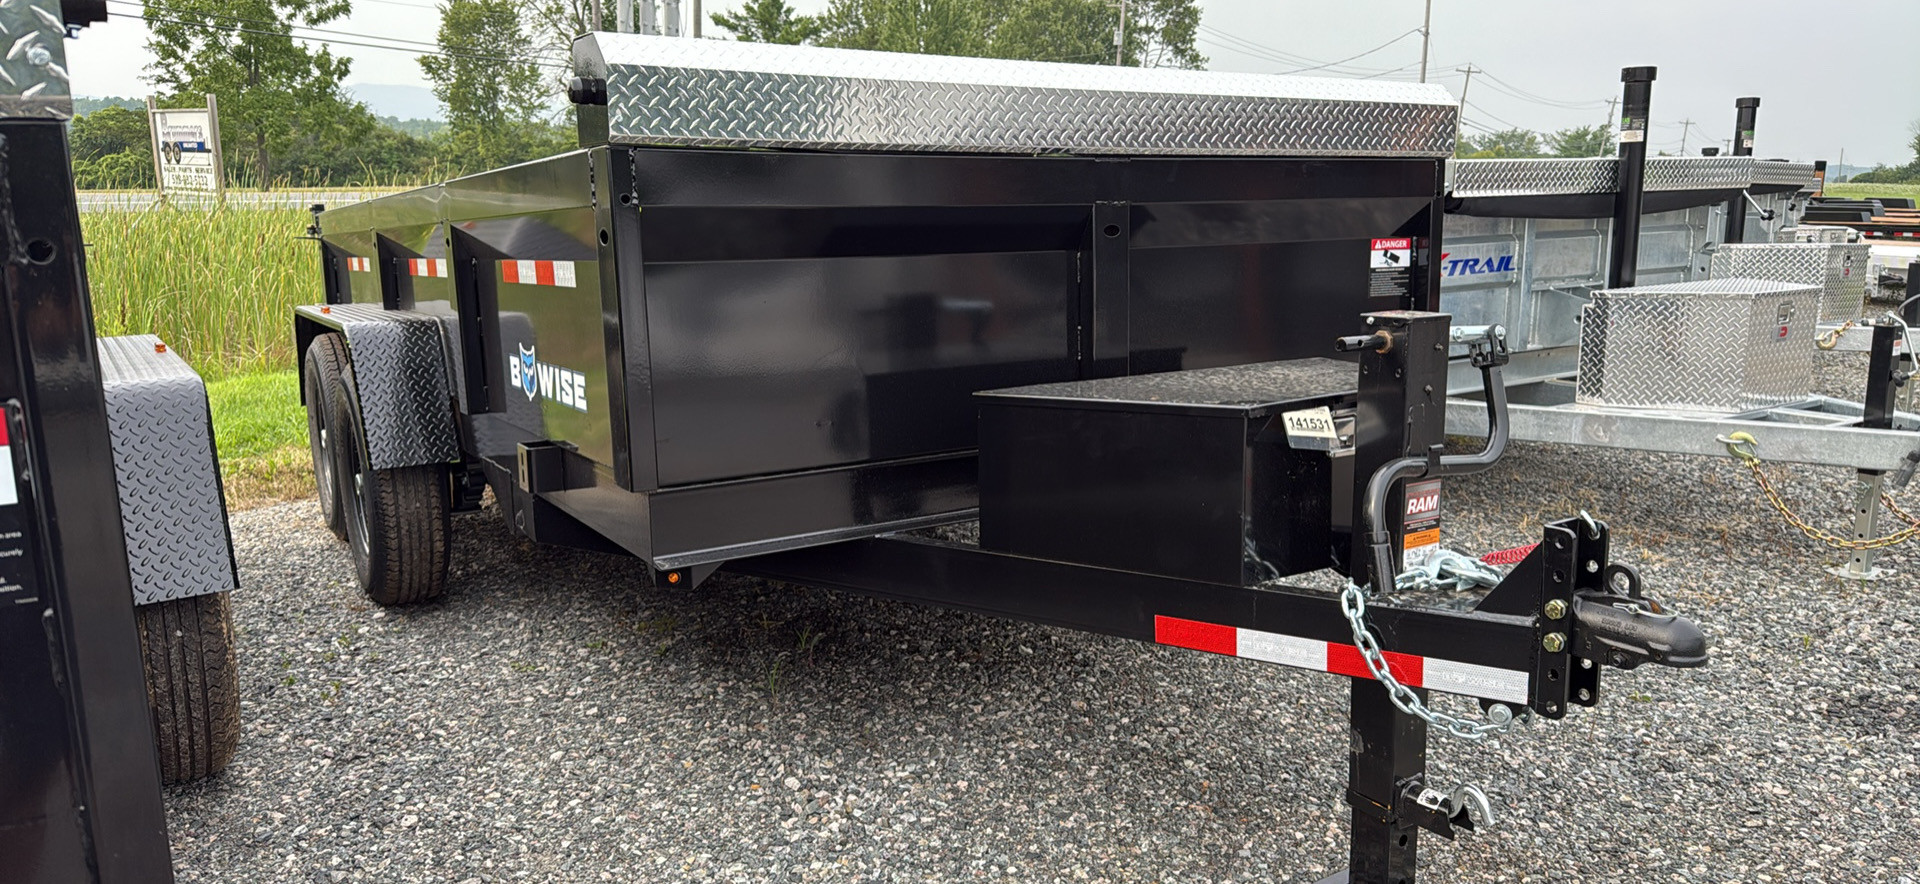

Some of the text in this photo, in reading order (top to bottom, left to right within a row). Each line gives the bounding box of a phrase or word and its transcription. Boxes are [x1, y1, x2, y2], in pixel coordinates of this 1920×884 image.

[1381, 239, 1408, 249] DANGER
[1441, 253, 1516, 277] -TRAIL
[1288, 416, 1331, 431] 141531
[1406, 494, 1439, 515] RAM
